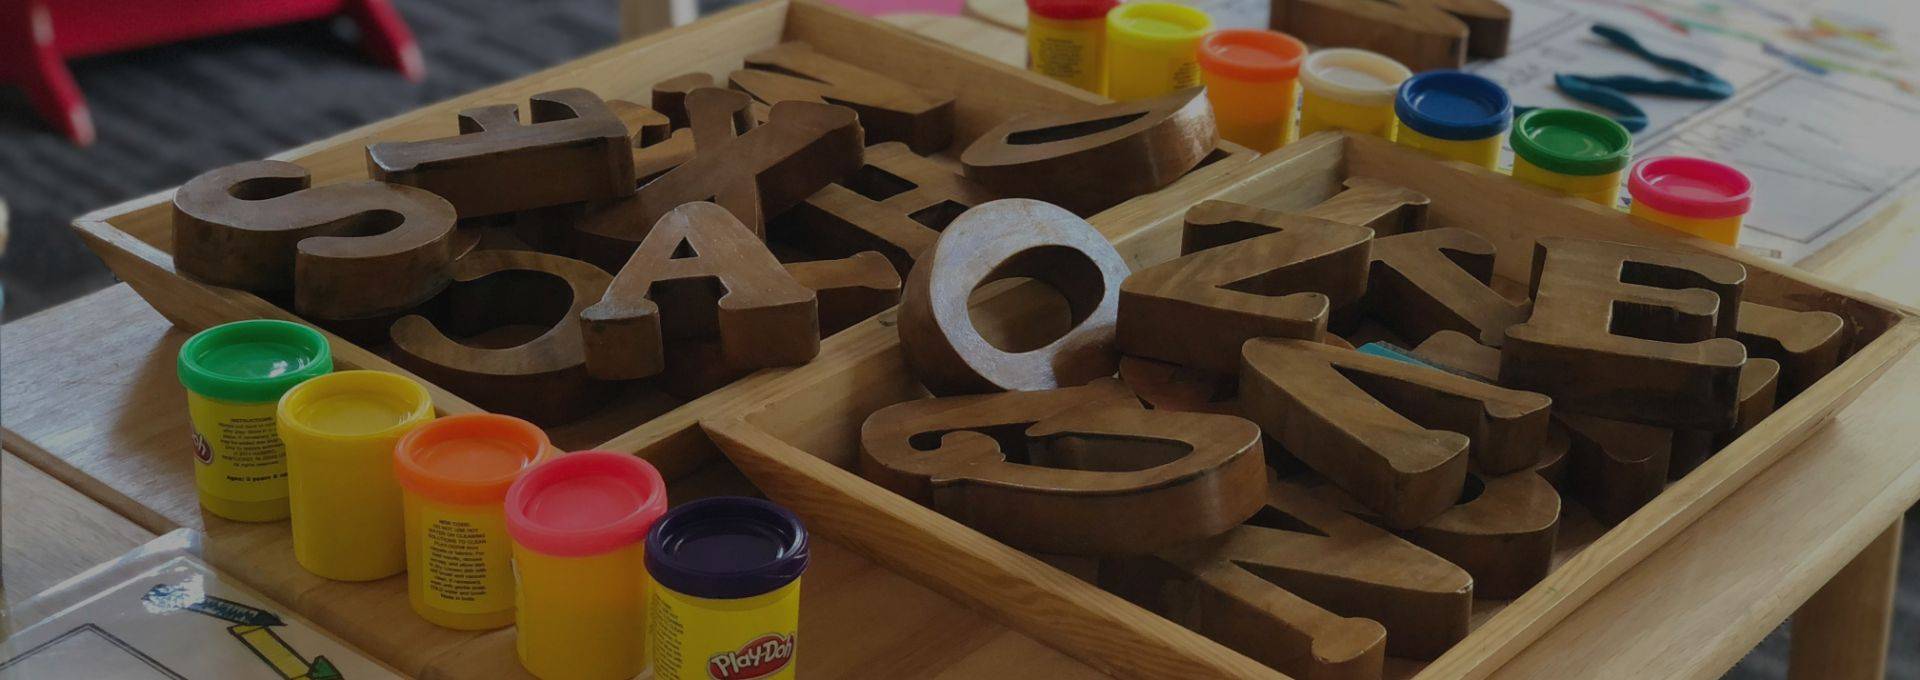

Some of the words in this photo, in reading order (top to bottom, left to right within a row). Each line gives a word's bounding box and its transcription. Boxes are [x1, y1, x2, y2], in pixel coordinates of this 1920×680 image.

[173, 160, 458, 319] S
[580, 201, 820, 380] A
[1503, 236, 1747, 430] E
[710, 634, 795, 678] Play-Doh
